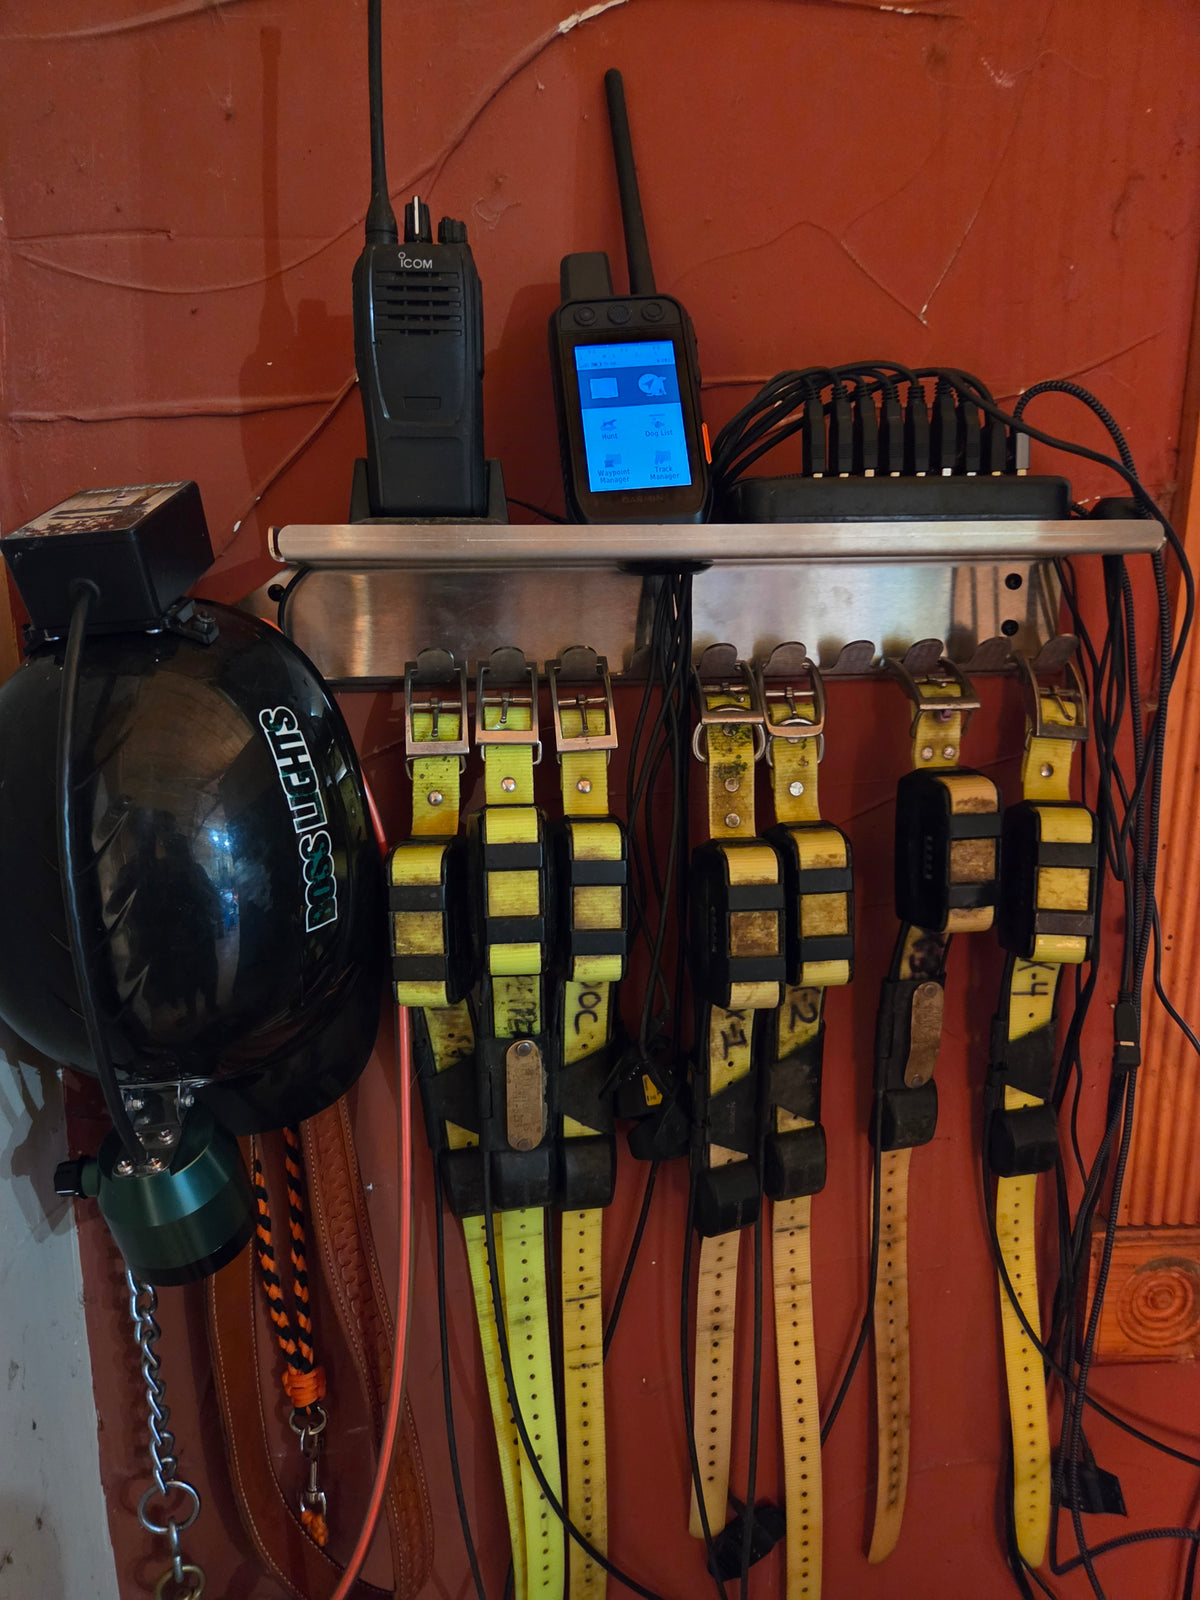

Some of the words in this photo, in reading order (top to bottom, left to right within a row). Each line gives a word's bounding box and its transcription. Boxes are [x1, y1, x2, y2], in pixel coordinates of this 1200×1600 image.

[598, 469, 630, 477] Waypoint
[655, 465, 672, 473] Track
[600, 476, 630, 484] Manager
[650, 472, 680, 482] Manager
[259, 706, 328, 833] LIGHTS
[299, 830, 338, 933] BOSS
